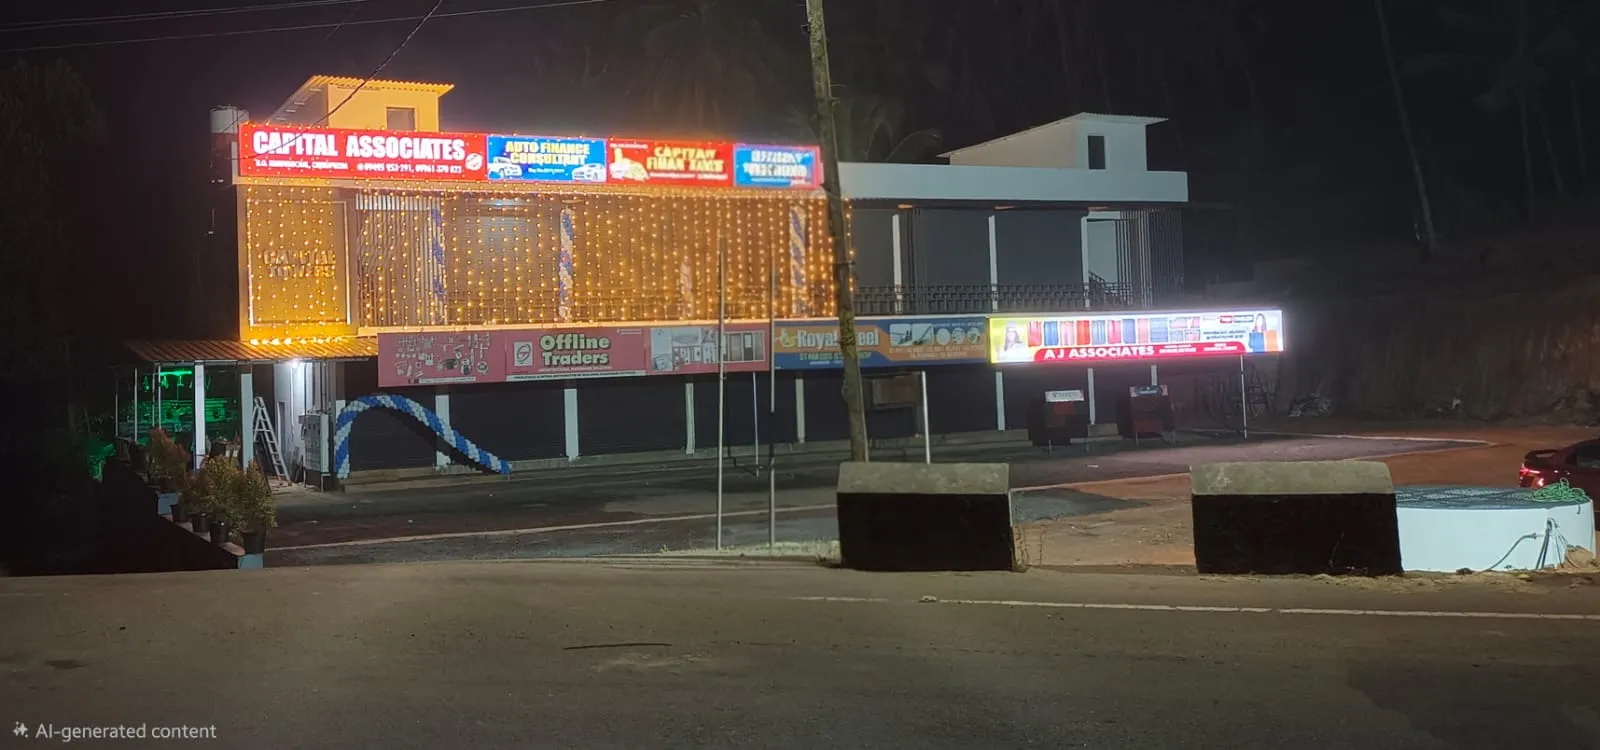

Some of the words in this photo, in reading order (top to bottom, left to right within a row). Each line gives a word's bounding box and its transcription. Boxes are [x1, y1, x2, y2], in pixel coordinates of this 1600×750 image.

[253, 131, 338, 156] CAPITAL
[346, 135, 465, 160] ASSOCIATES
[505, 141, 539, 153] AUTO
[540, 142, 590, 154] FINANCE
[540, 333, 611, 351] Offline
[797, 328, 838, 350] Royal
[542, 350, 609, 366] Traders
[1068, 345, 1155, 358] ASSOCIATES
